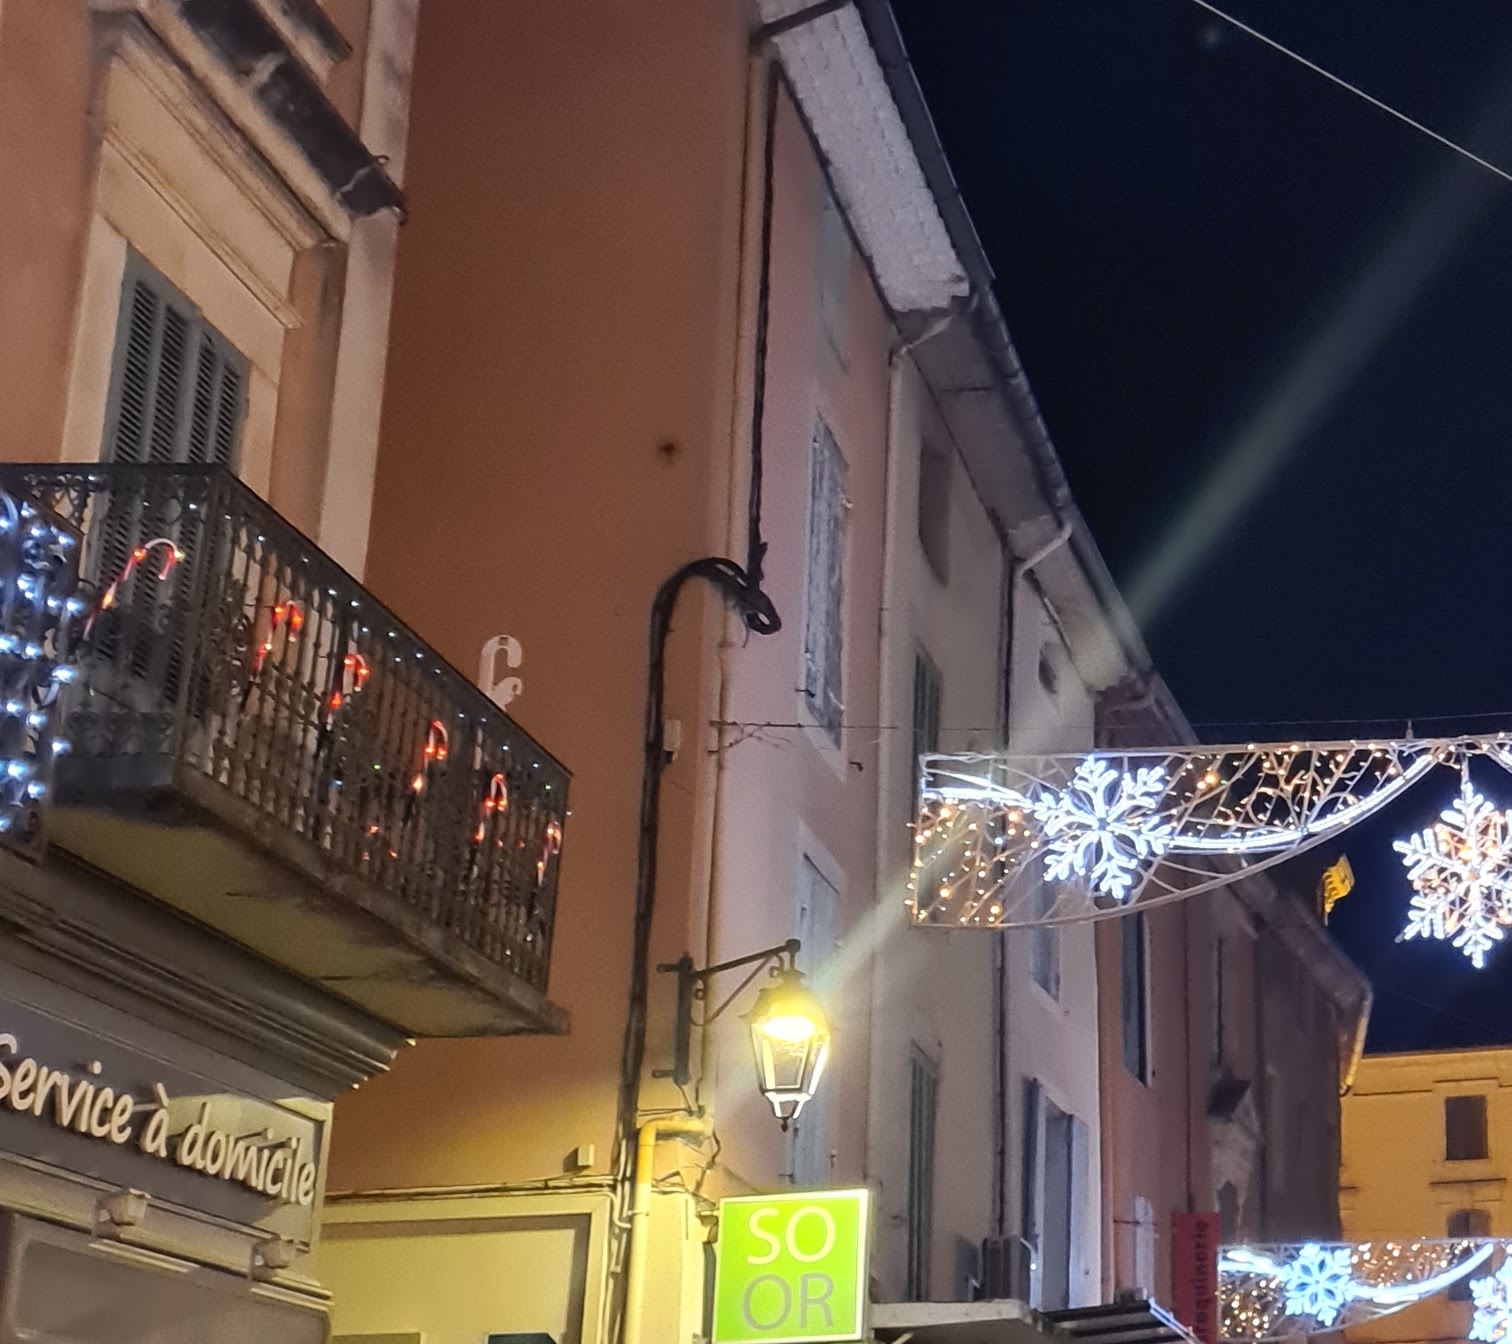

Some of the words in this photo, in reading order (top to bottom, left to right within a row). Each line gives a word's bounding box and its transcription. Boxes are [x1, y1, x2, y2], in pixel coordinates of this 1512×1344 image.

[0, 1033, 134, 1144] Service
[140, 1082, 170, 1158] à
[177, 1101, 317, 1206] domicile
[746, 1205, 837, 1266] SO
[742, 1272, 834, 1332] OR
